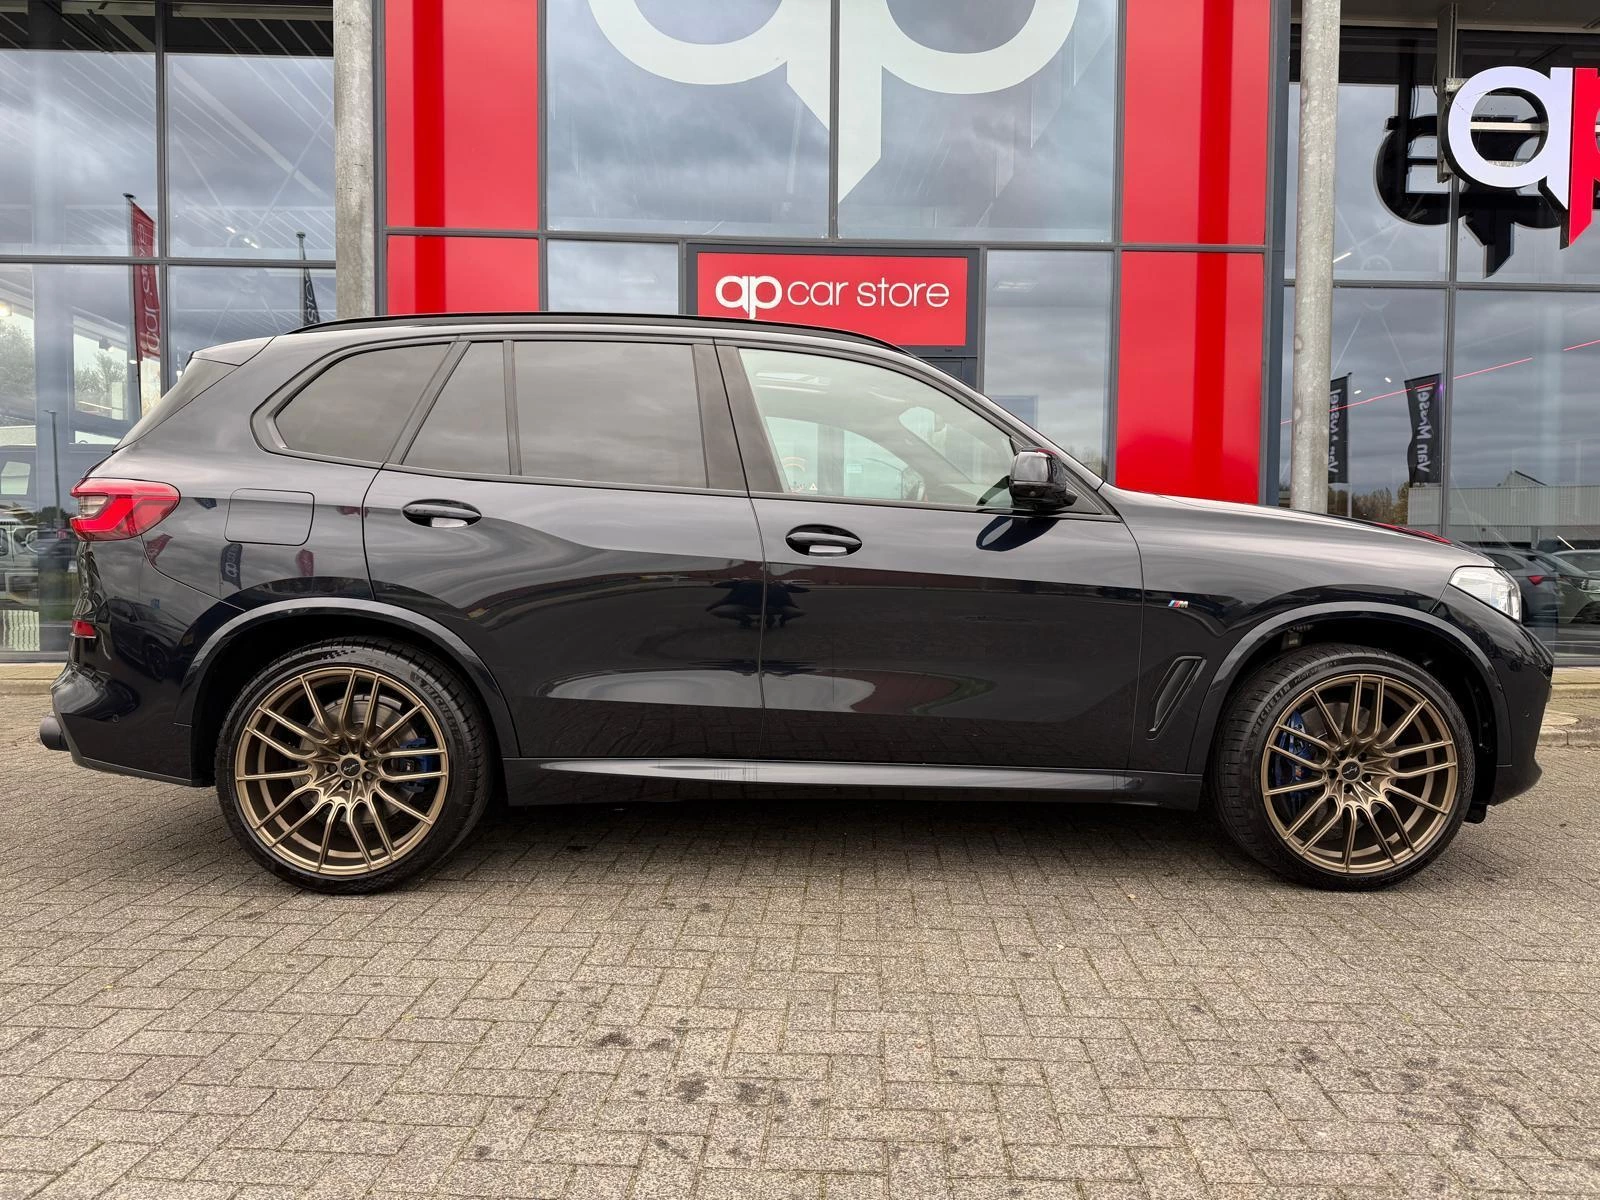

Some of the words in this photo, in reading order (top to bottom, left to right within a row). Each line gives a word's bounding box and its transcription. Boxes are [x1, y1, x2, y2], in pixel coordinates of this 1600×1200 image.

[715, 275, 782, 319] ap
[787, 281, 848, 307] car
[857, 277, 950, 307] store
